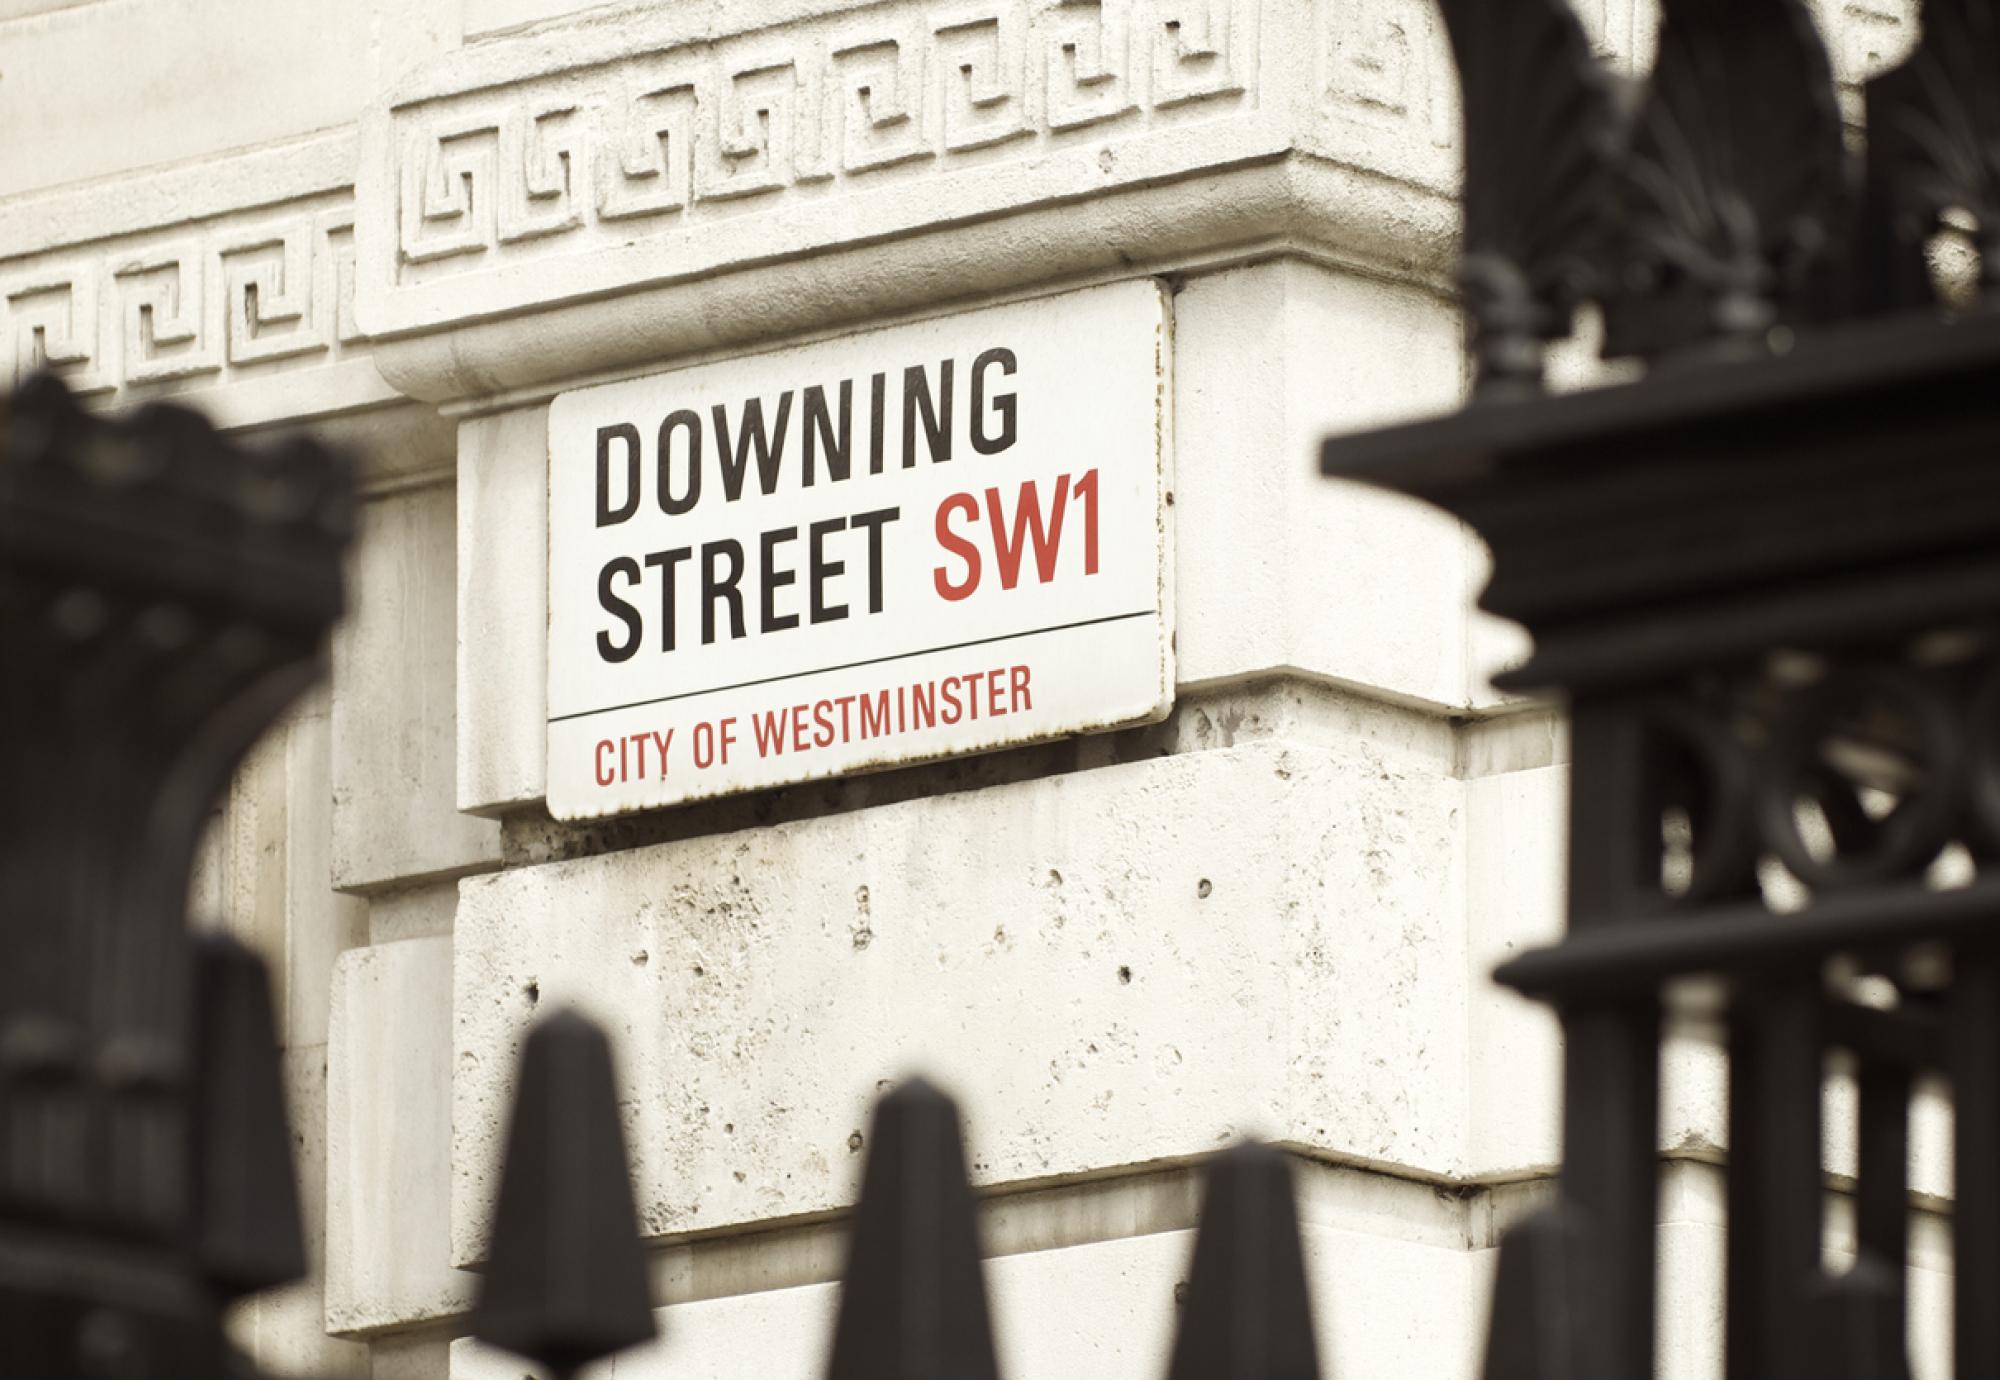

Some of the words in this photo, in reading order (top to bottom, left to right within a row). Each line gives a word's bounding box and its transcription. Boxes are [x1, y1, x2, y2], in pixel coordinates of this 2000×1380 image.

[596, 347, 1017, 528] DOWNING
[596, 506, 900, 664] STREET
[933, 469, 1099, 602] SW1
[595, 728, 673, 787] CITY
[693, 718, 738, 770] OF
[751, 664, 1032, 757] WESTMINSTER
